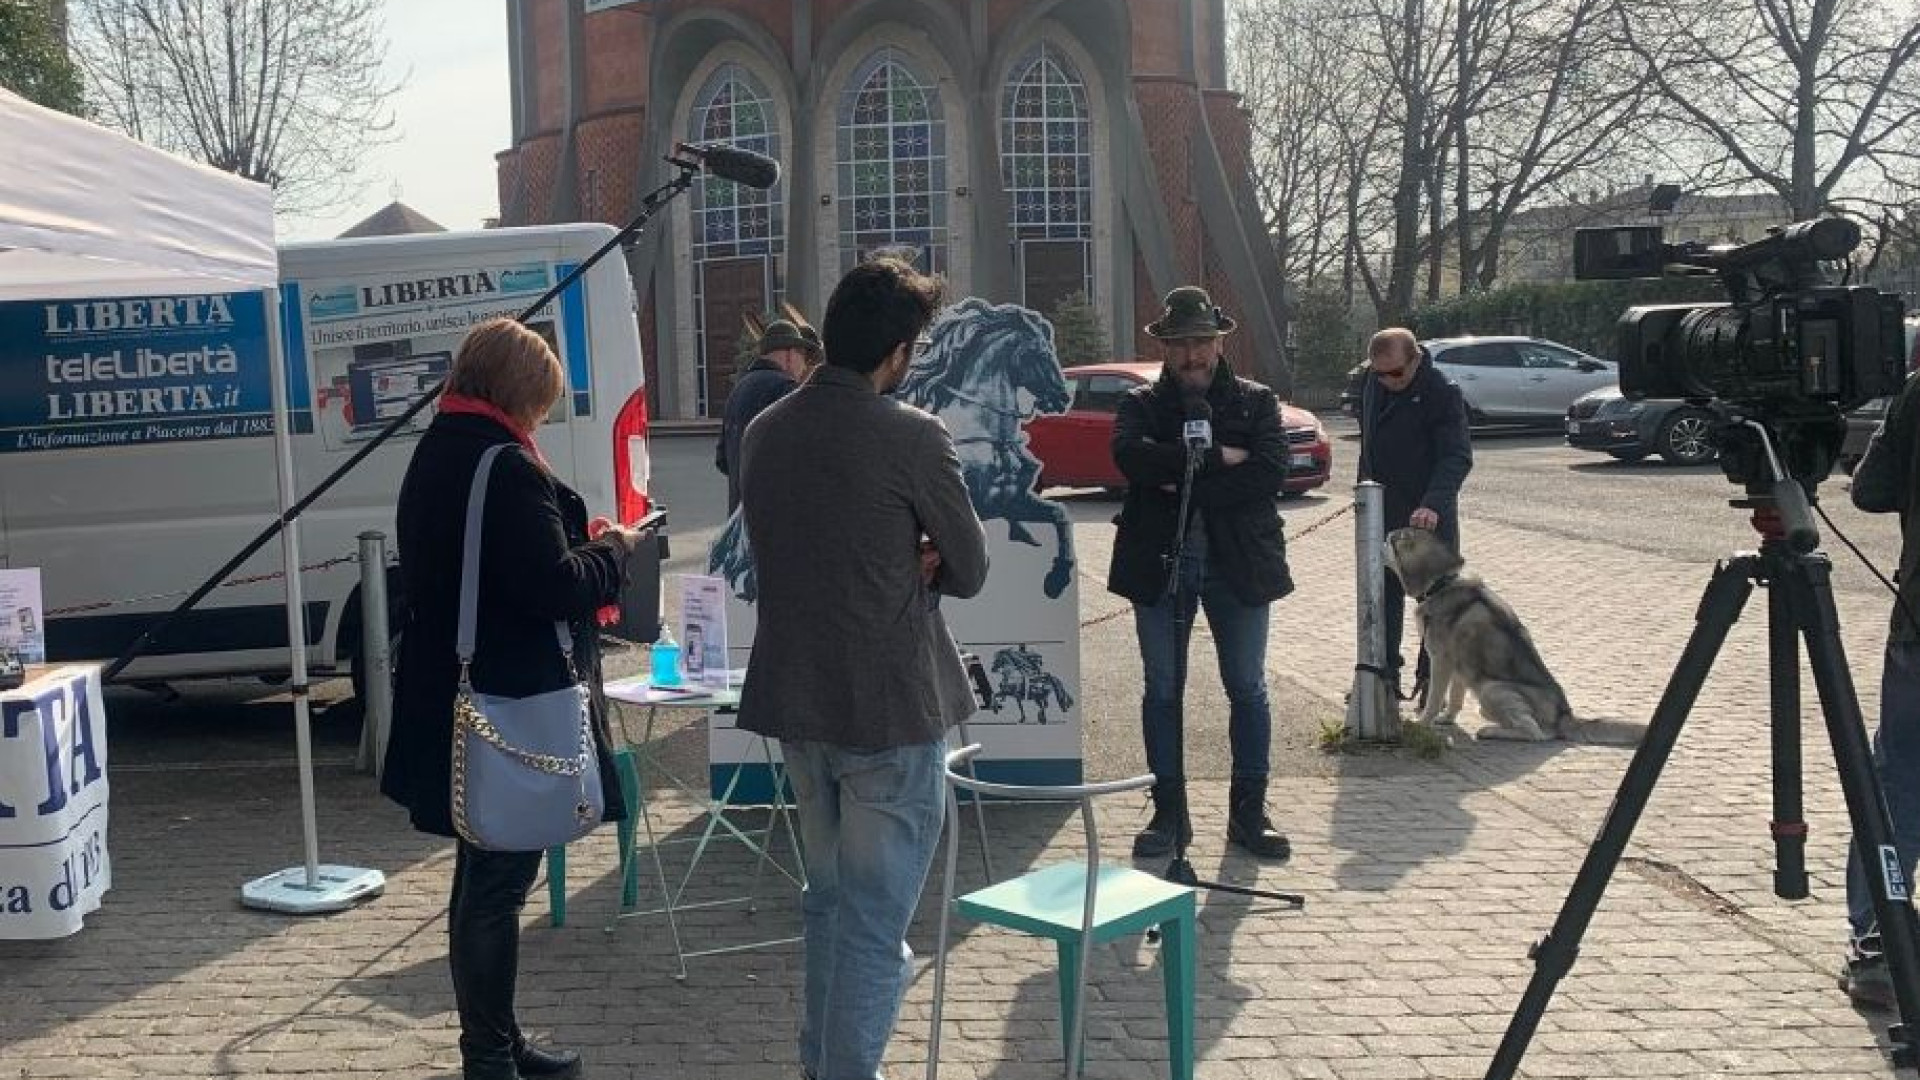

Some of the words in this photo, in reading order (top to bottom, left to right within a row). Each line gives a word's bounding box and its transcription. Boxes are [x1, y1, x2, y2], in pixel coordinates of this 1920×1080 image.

[311, 328, 355, 346] Unisce
[426, 311, 466, 331] unisce
[46, 343, 238, 383] teleLibertà
[17, 430, 129, 449] L'informazione
[131, 430, 142, 443] a
[145, 425, 211, 439] Piacenza
[213, 419, 238, 434] dal
